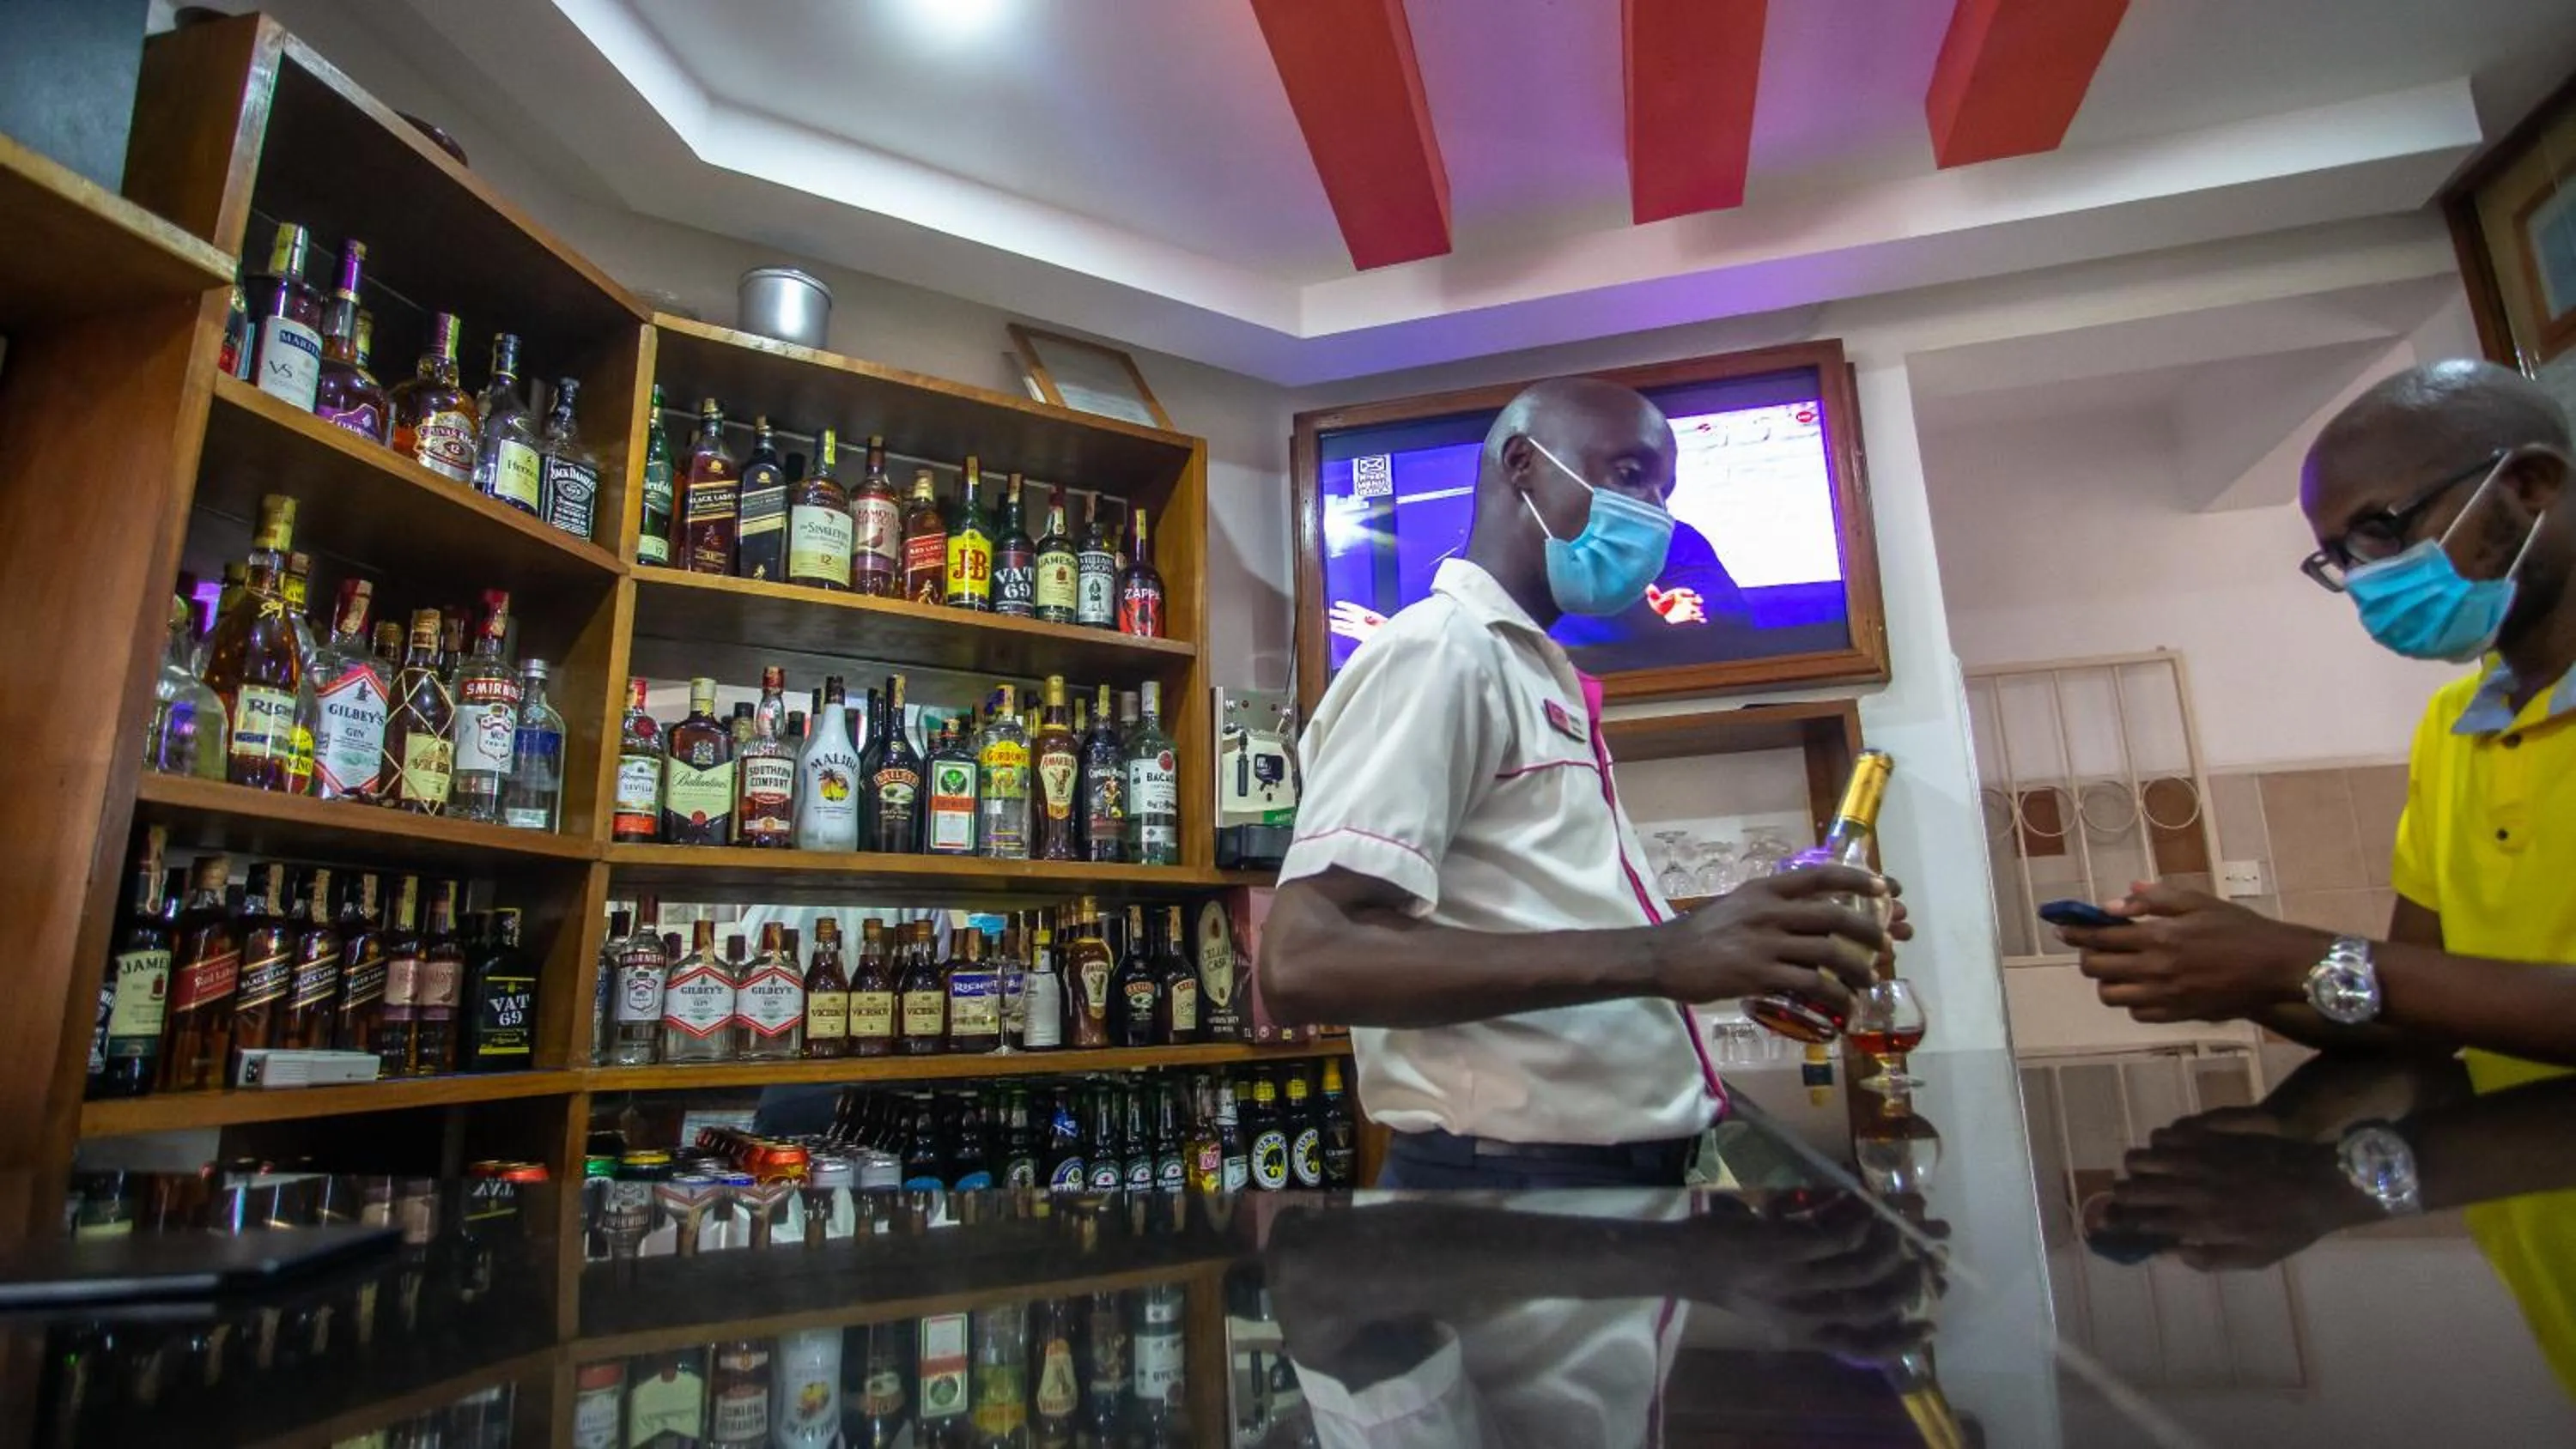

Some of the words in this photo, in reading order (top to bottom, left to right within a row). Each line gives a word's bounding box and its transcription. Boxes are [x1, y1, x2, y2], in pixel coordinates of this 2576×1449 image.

[269, 360, 293, 378] VS
[821, 555, 832, 565] 12
[994, 566, 1034, 584] VAT
[1004, 583, 1030, 598] 69
[329, 703, 385, 726] GILBEY'S
[345, 727, 365, 738] GIN
[749, 767, 791, 778] SOUTHERN
[750, 777, 788, 789] COMFORT
[489, 994, 530, 1012] VAT
[499, 1011, 523, 1026] 69
